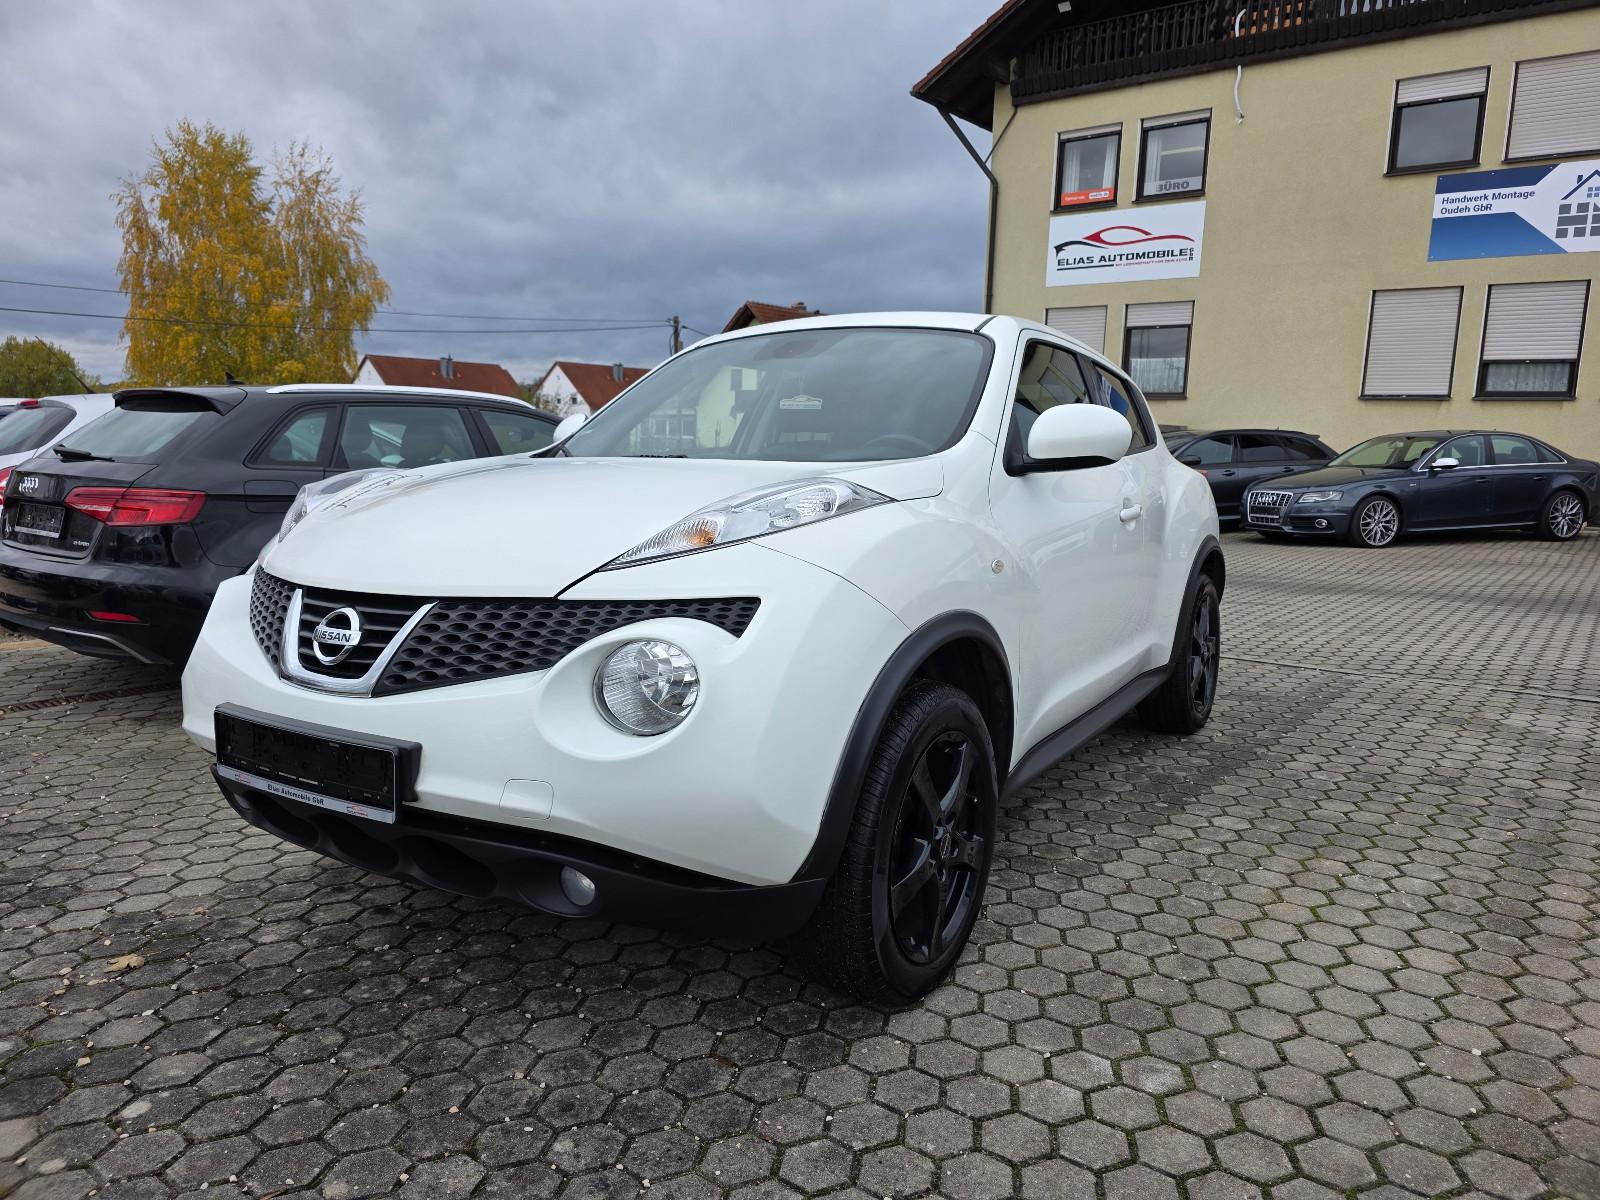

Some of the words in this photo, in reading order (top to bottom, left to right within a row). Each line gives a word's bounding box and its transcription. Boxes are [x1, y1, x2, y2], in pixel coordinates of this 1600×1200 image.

[1156, 181, 1190, 192] BÜRO
[1441, 193, 1489, 205] Handwerk
[1491, 190, 1535, 201] Montage
[1440, 205, 1471, 215] Oudeh
[1473, 203, 1493, 212] GbR
[1057, 256, 1095, 266] ELIAS
[1098, 247, 1188, 263] AUTOMOBILE
[314, 629, 352, 642] NISSAN
